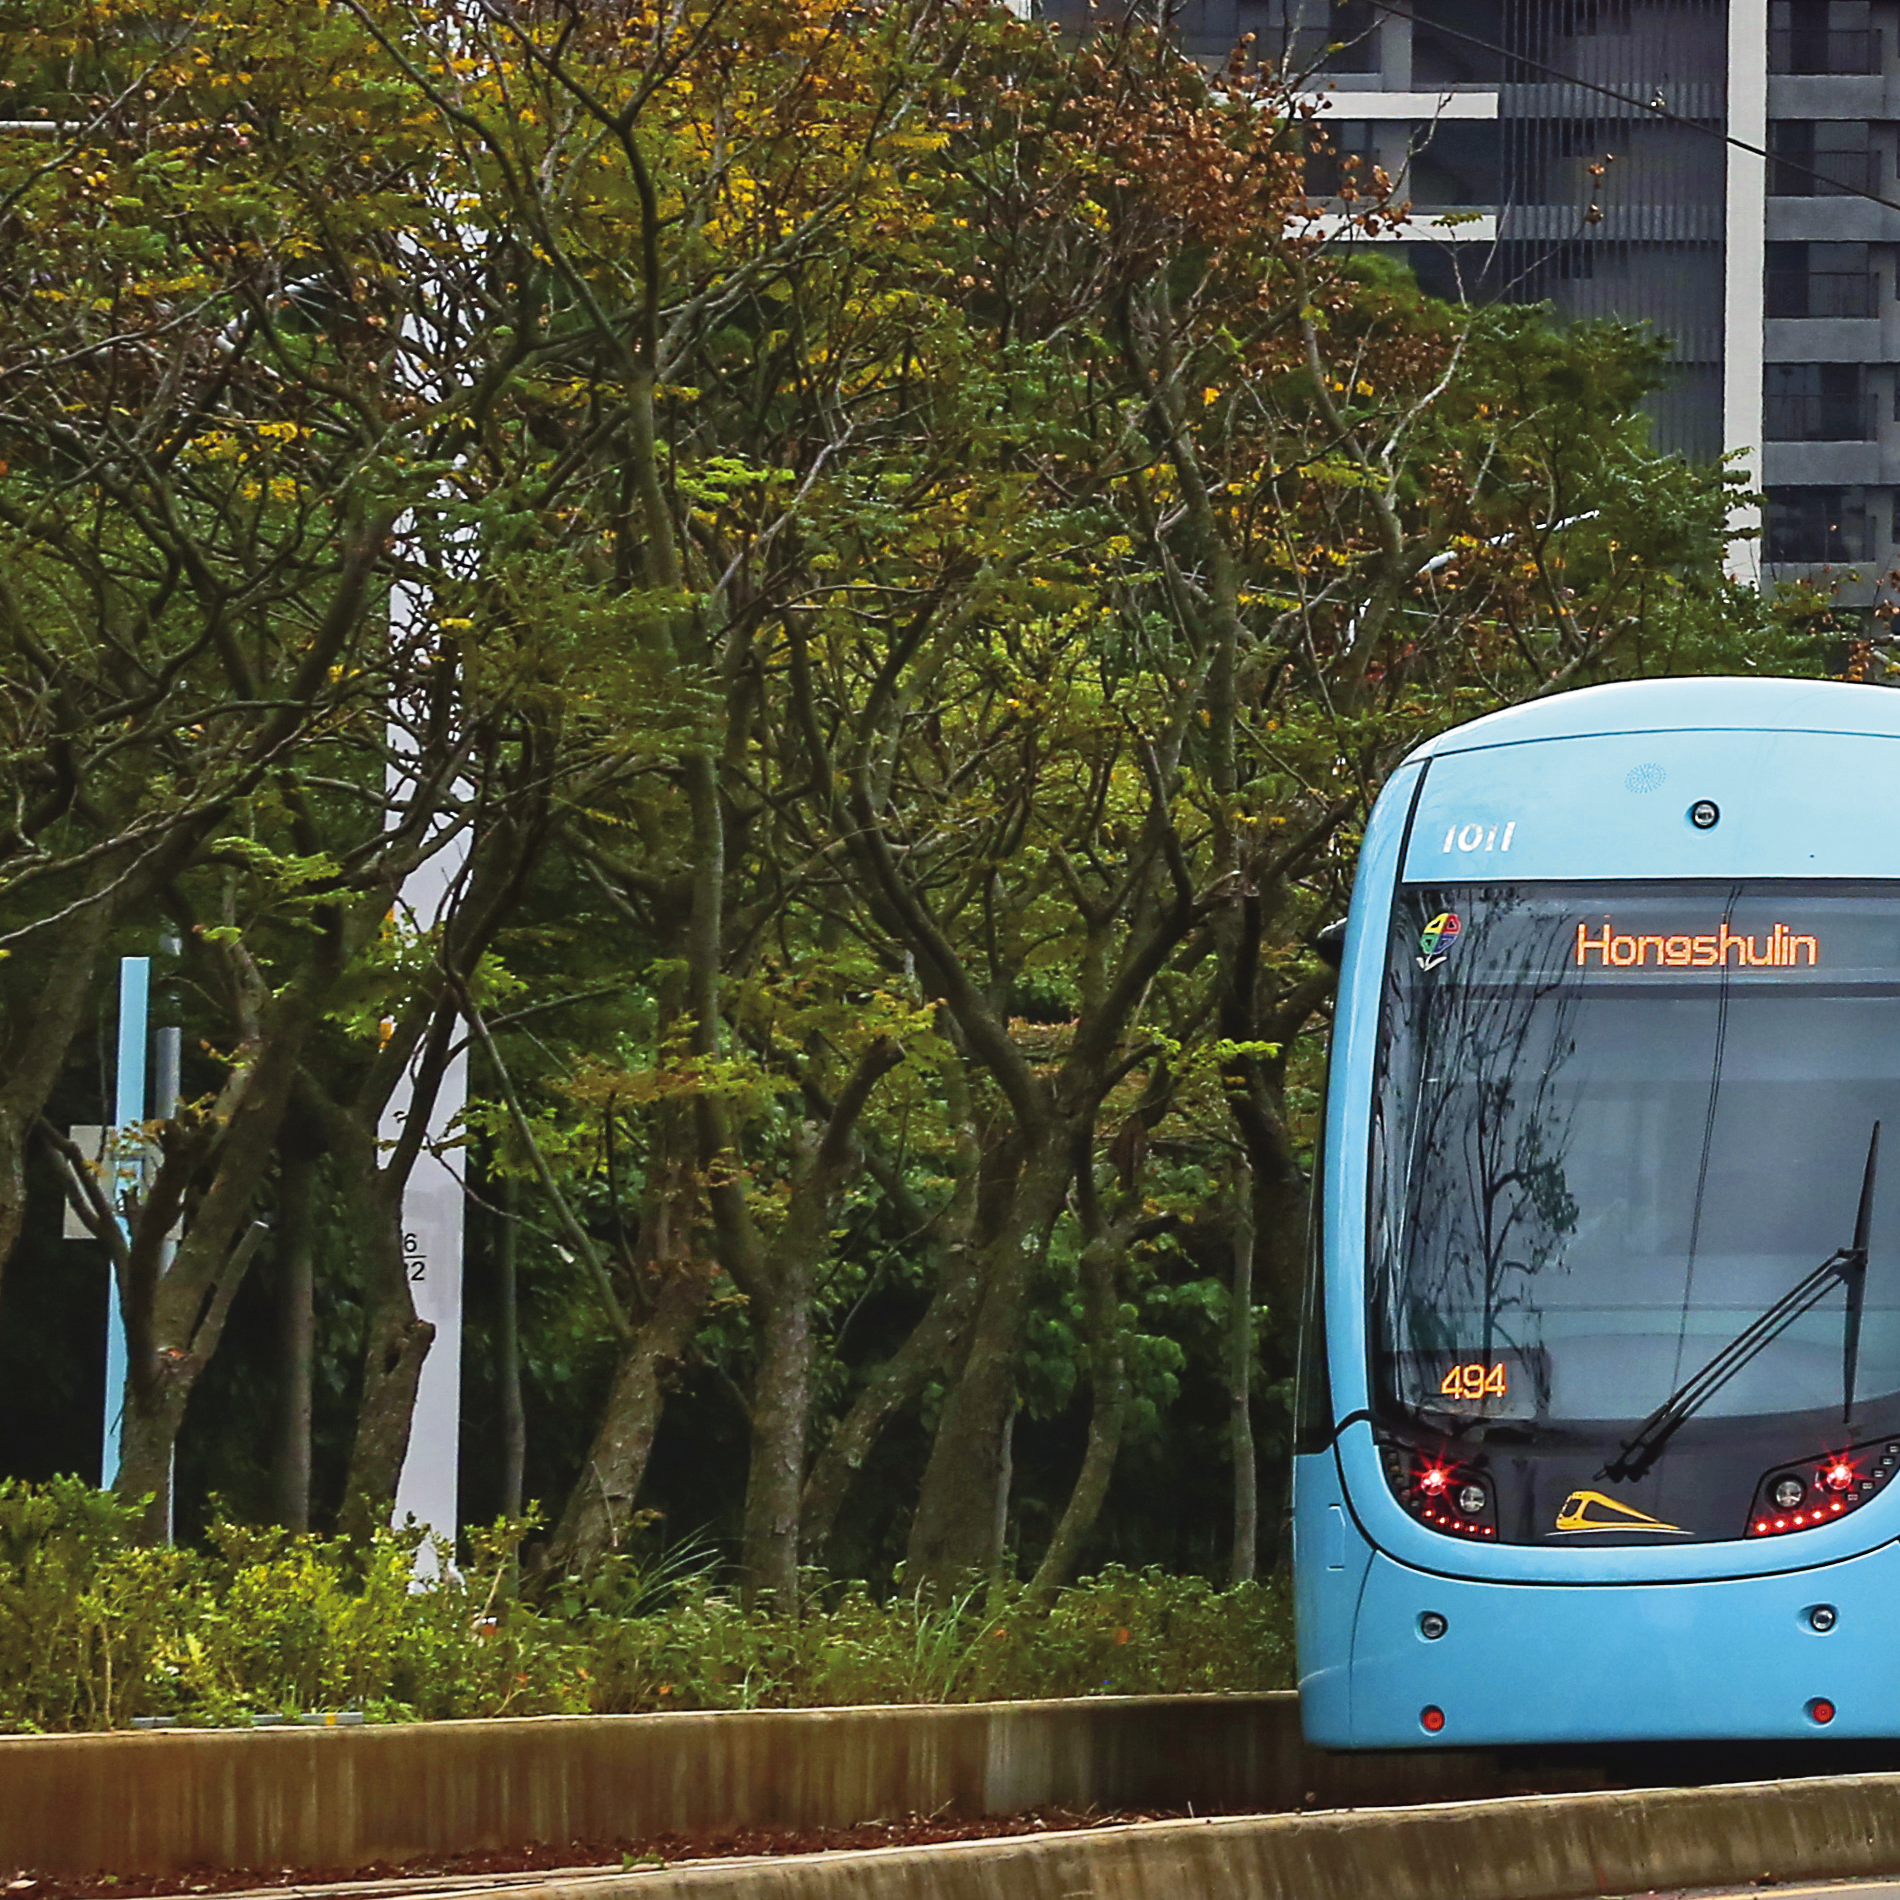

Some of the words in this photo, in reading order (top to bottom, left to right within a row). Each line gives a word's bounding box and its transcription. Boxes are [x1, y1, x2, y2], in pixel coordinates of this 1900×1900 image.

[1442, 821, 1516, 853] 1011
[1576, 923, 1818, 966] Hongshulin
[1441, 1362, 1507, 1400] 494
